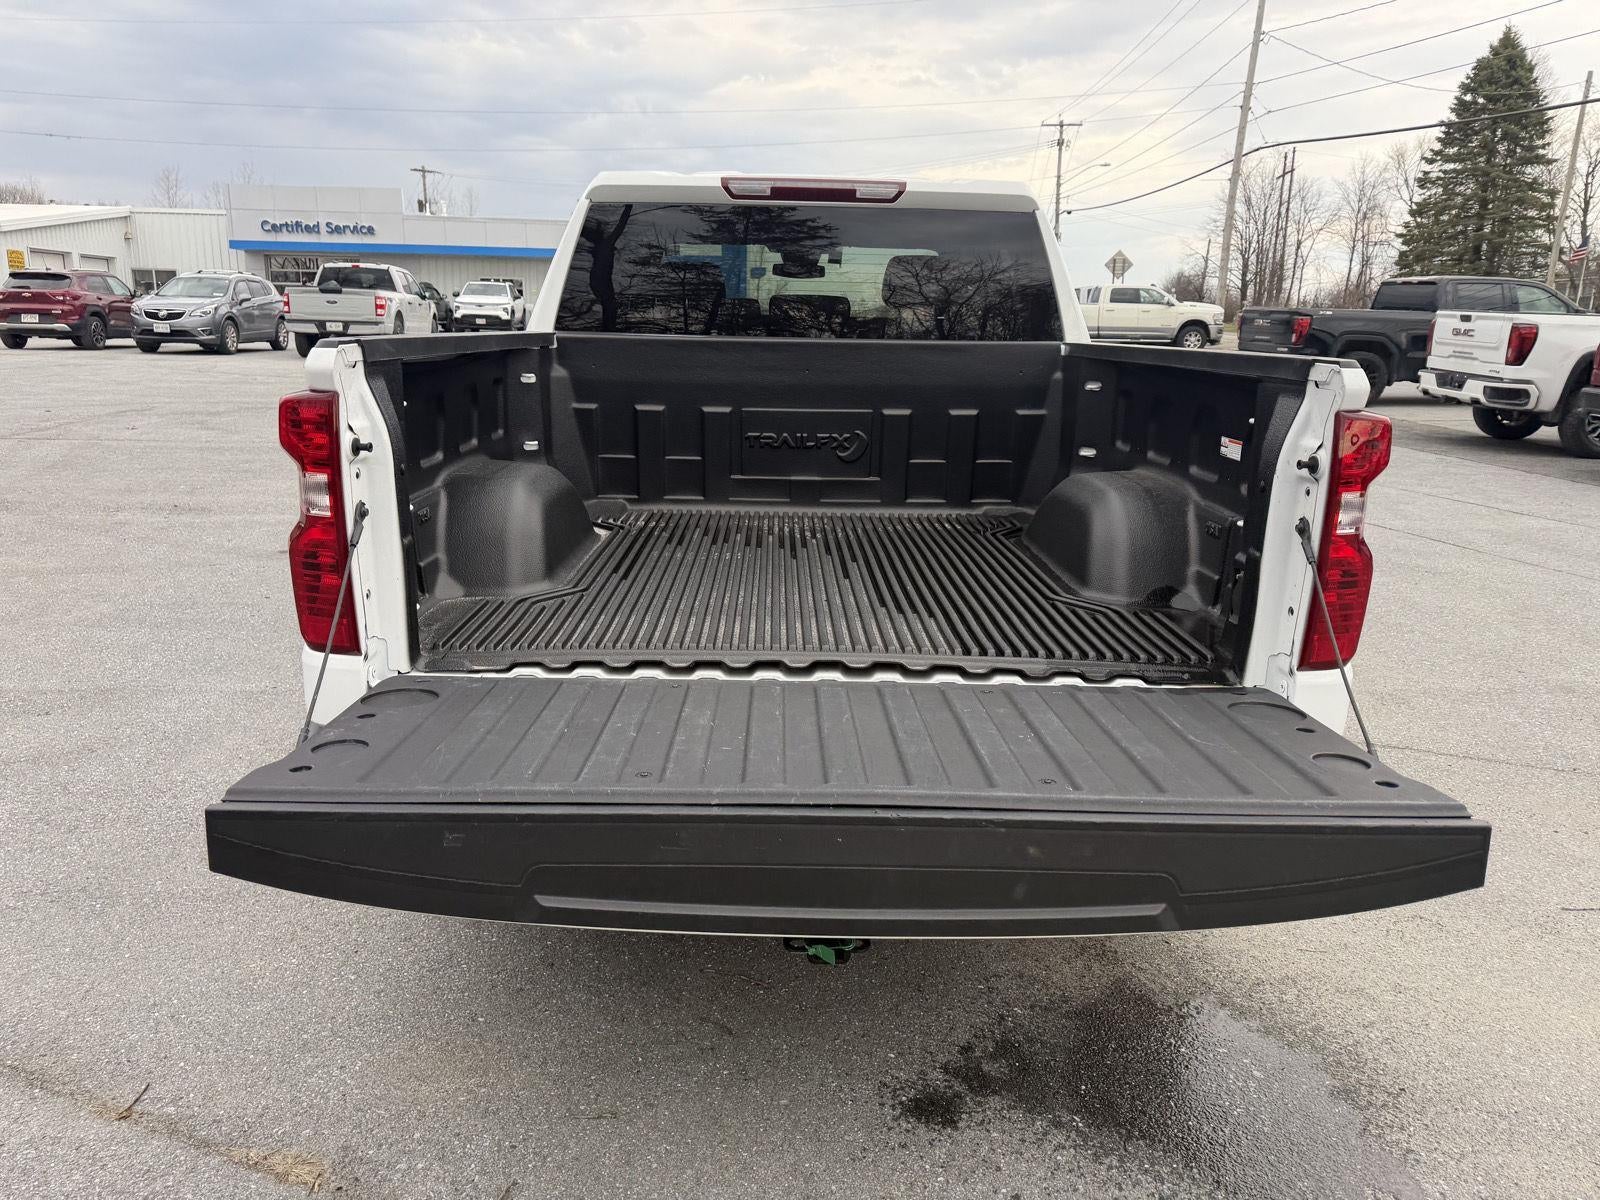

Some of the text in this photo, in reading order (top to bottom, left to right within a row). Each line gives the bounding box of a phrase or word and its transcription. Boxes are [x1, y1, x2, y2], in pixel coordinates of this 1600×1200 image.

[261, 220, 376, 236] Certified Service
[1451, 327, 1475, 337] GMC
[745, 432, 852, 450] TRAILFX
